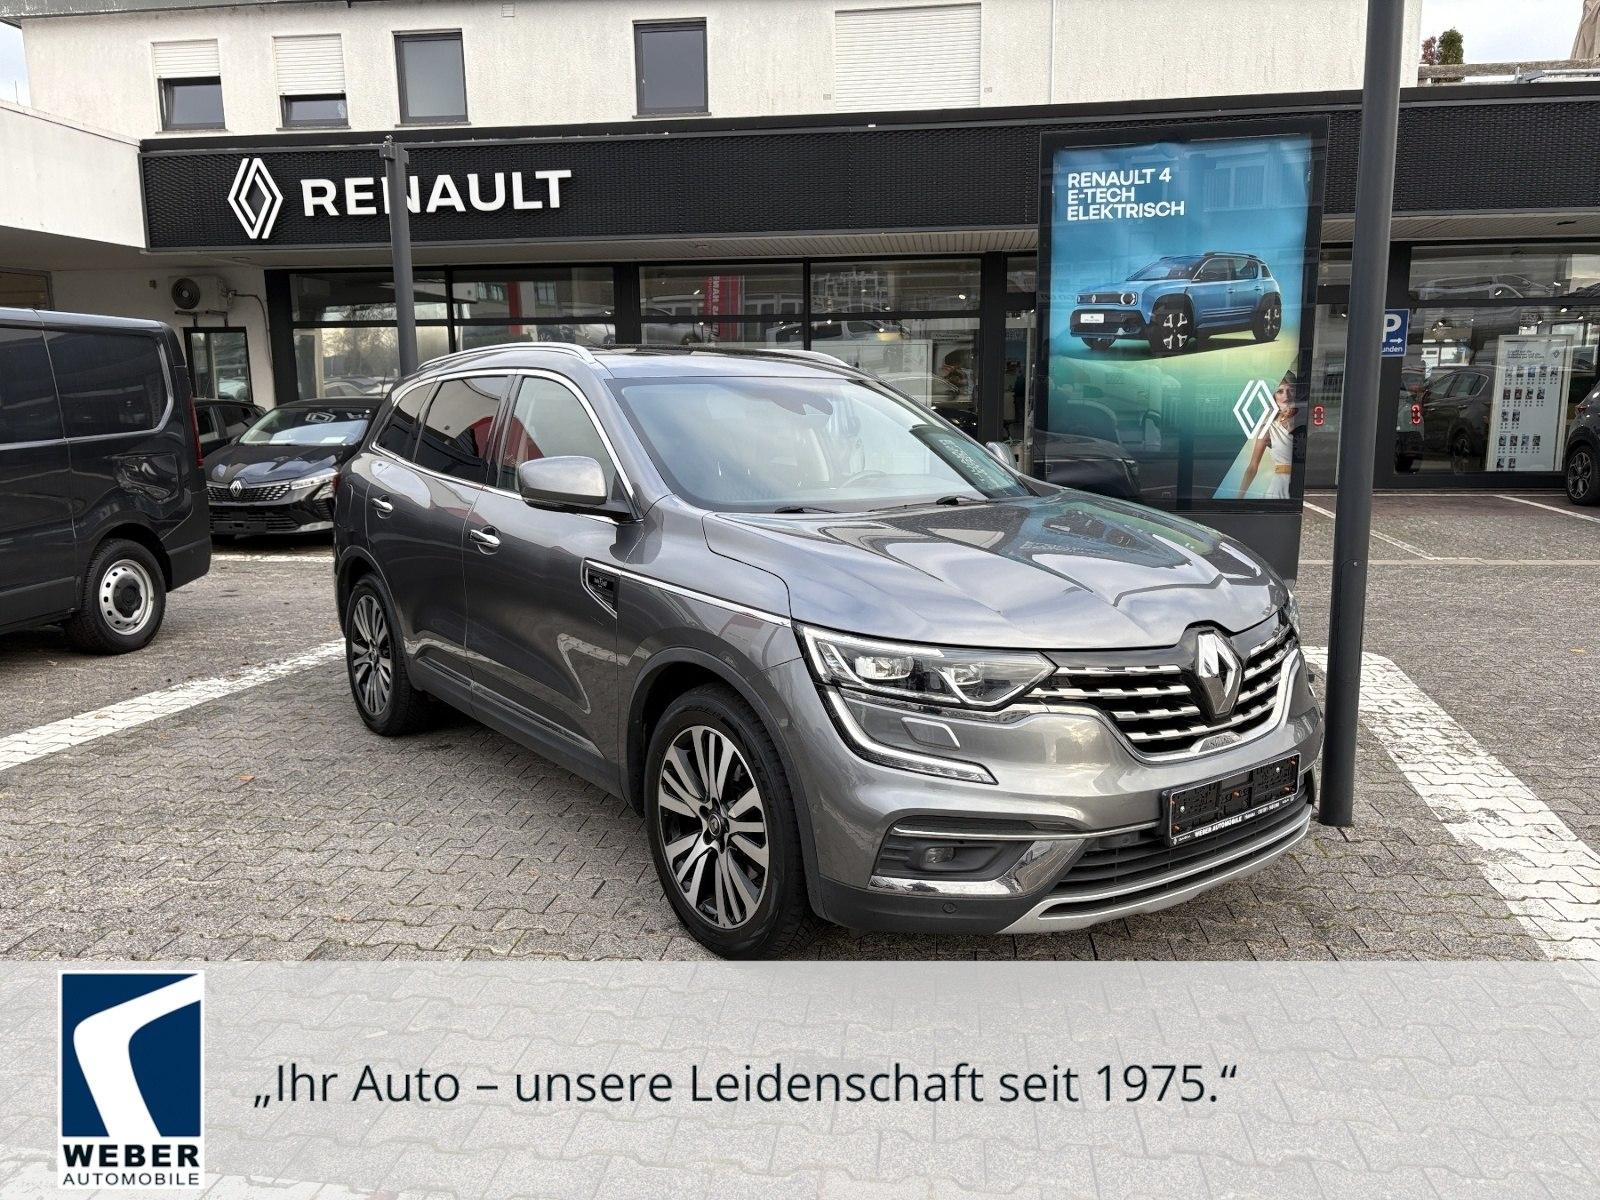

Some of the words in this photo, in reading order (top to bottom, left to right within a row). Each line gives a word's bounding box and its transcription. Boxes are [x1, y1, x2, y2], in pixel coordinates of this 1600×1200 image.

[1067, 168, 1156, 189] RENAULT
[1158, 167, 1172, 183] 4
[300, 169, 573, 217] RENAULT
[1067, 186, 1135, 205] E-TECH
[1067, 200, 1185, 221] ELEKTRISCH
[1382, 313, 1402, 343] P
